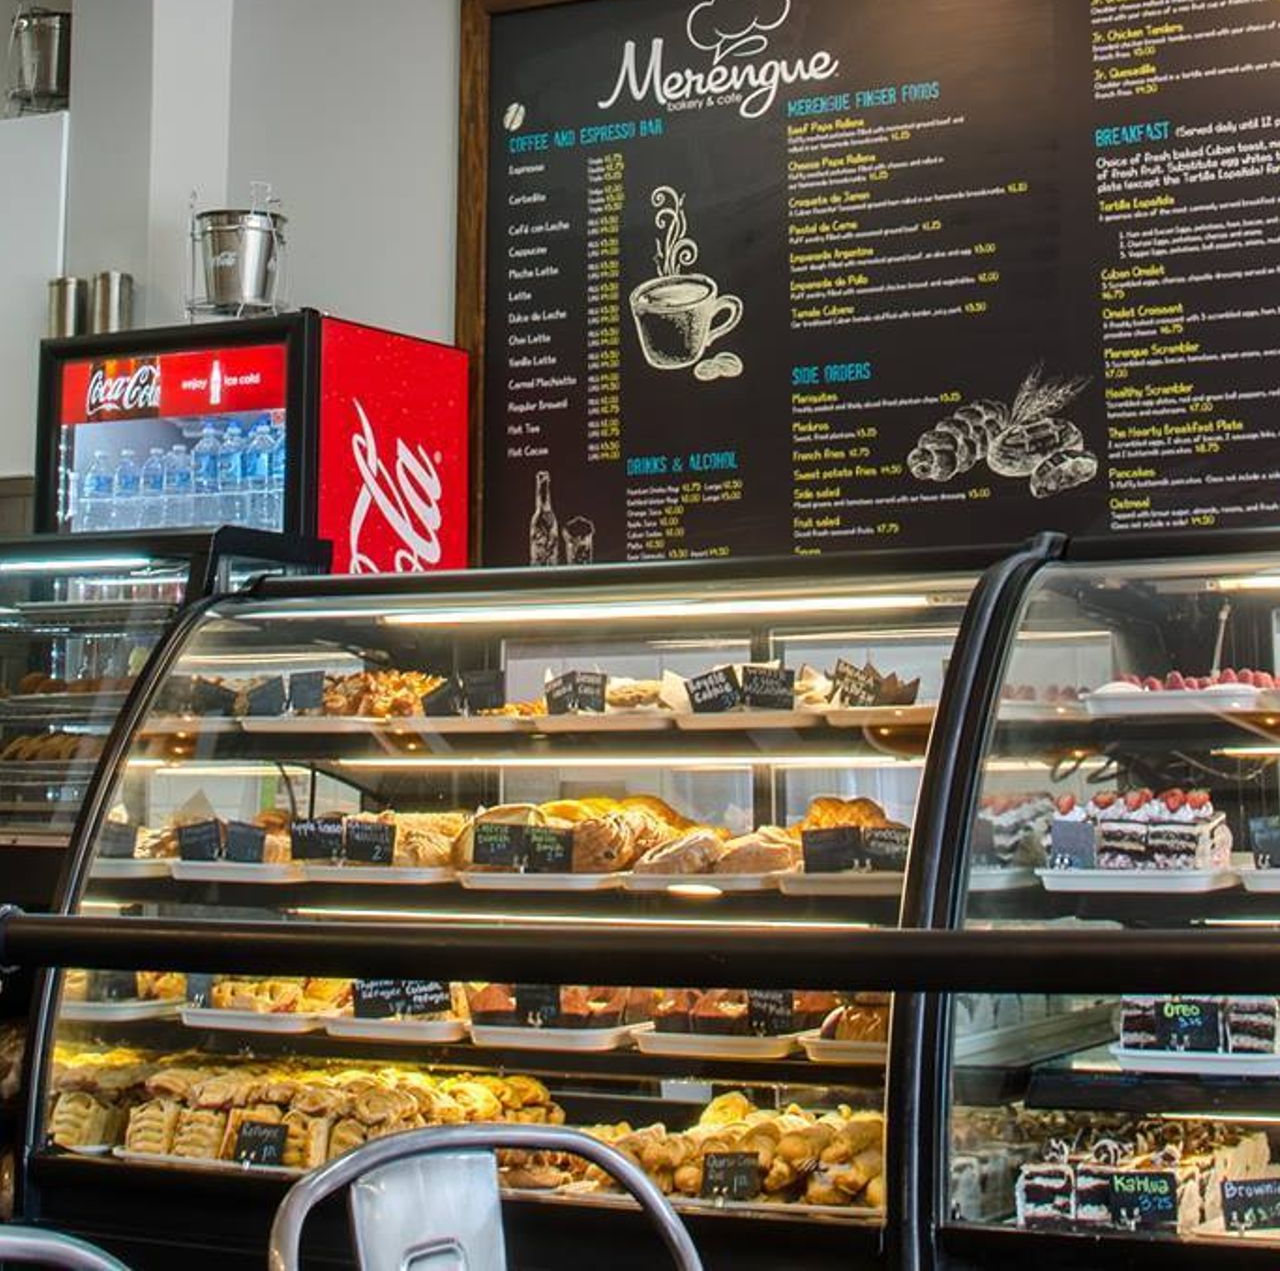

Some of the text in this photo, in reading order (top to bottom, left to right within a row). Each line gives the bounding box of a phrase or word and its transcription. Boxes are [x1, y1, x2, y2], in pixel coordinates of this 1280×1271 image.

[707, 97, 715, 108] &
[1094, 122, 1169, 145] BREAKFAST
[1174, 123, 1213, 137] (Served
[1214, 120, 1237, 133] daily
[1237, 117, 1259, 130] until
[1260, 115, 1272, 128] 12
[181, 372, 262, 391] enjoy ice cold
[791, 363, 871, 384] SIDE ORDERS
